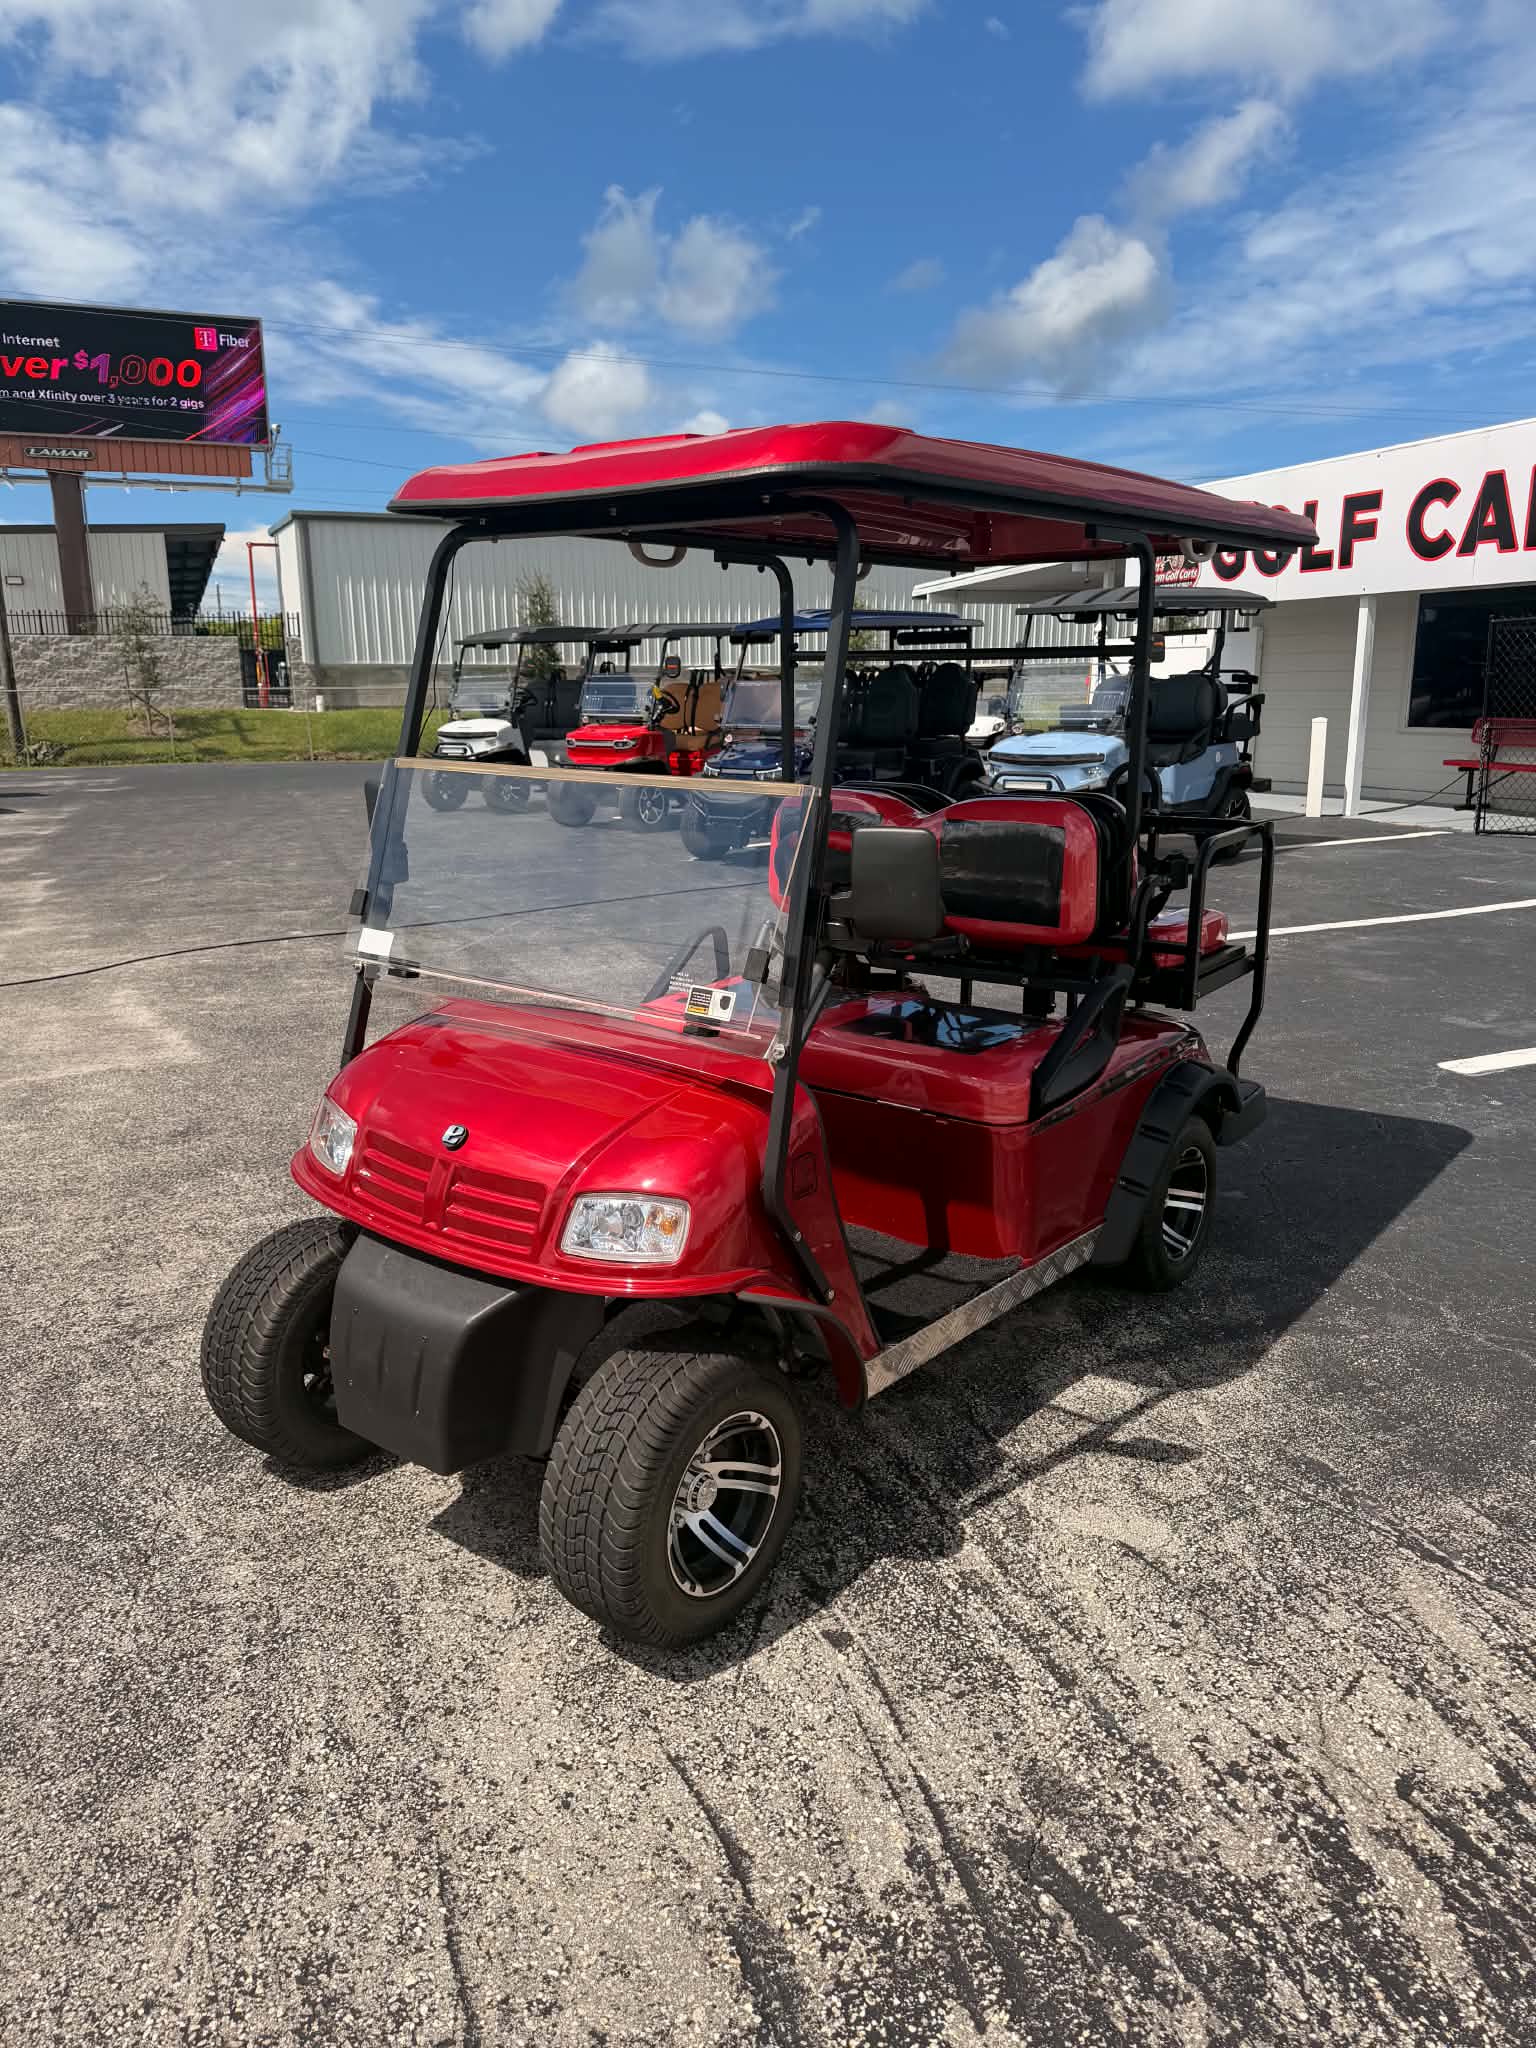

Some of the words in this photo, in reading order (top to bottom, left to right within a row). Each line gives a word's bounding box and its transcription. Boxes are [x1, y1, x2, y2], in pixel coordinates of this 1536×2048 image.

[2, 332, 61, 348] Internet
[218, 333, 250, 348] Fiber
[72, 348, 202, 388] $1,000
[12, 389, 36, 399] and
[38, 389, 78, 403] Xfinity
[80, 393, 107, 403] over
[107, 393, 116, 404] 3
[117, 395, 150, 406] years
[152, 395, 168, 406] for
[170, 396, 178, 407] 2
[180, 396, 205, 410] gigs
[29, 448, 90, 458] LAMAR
